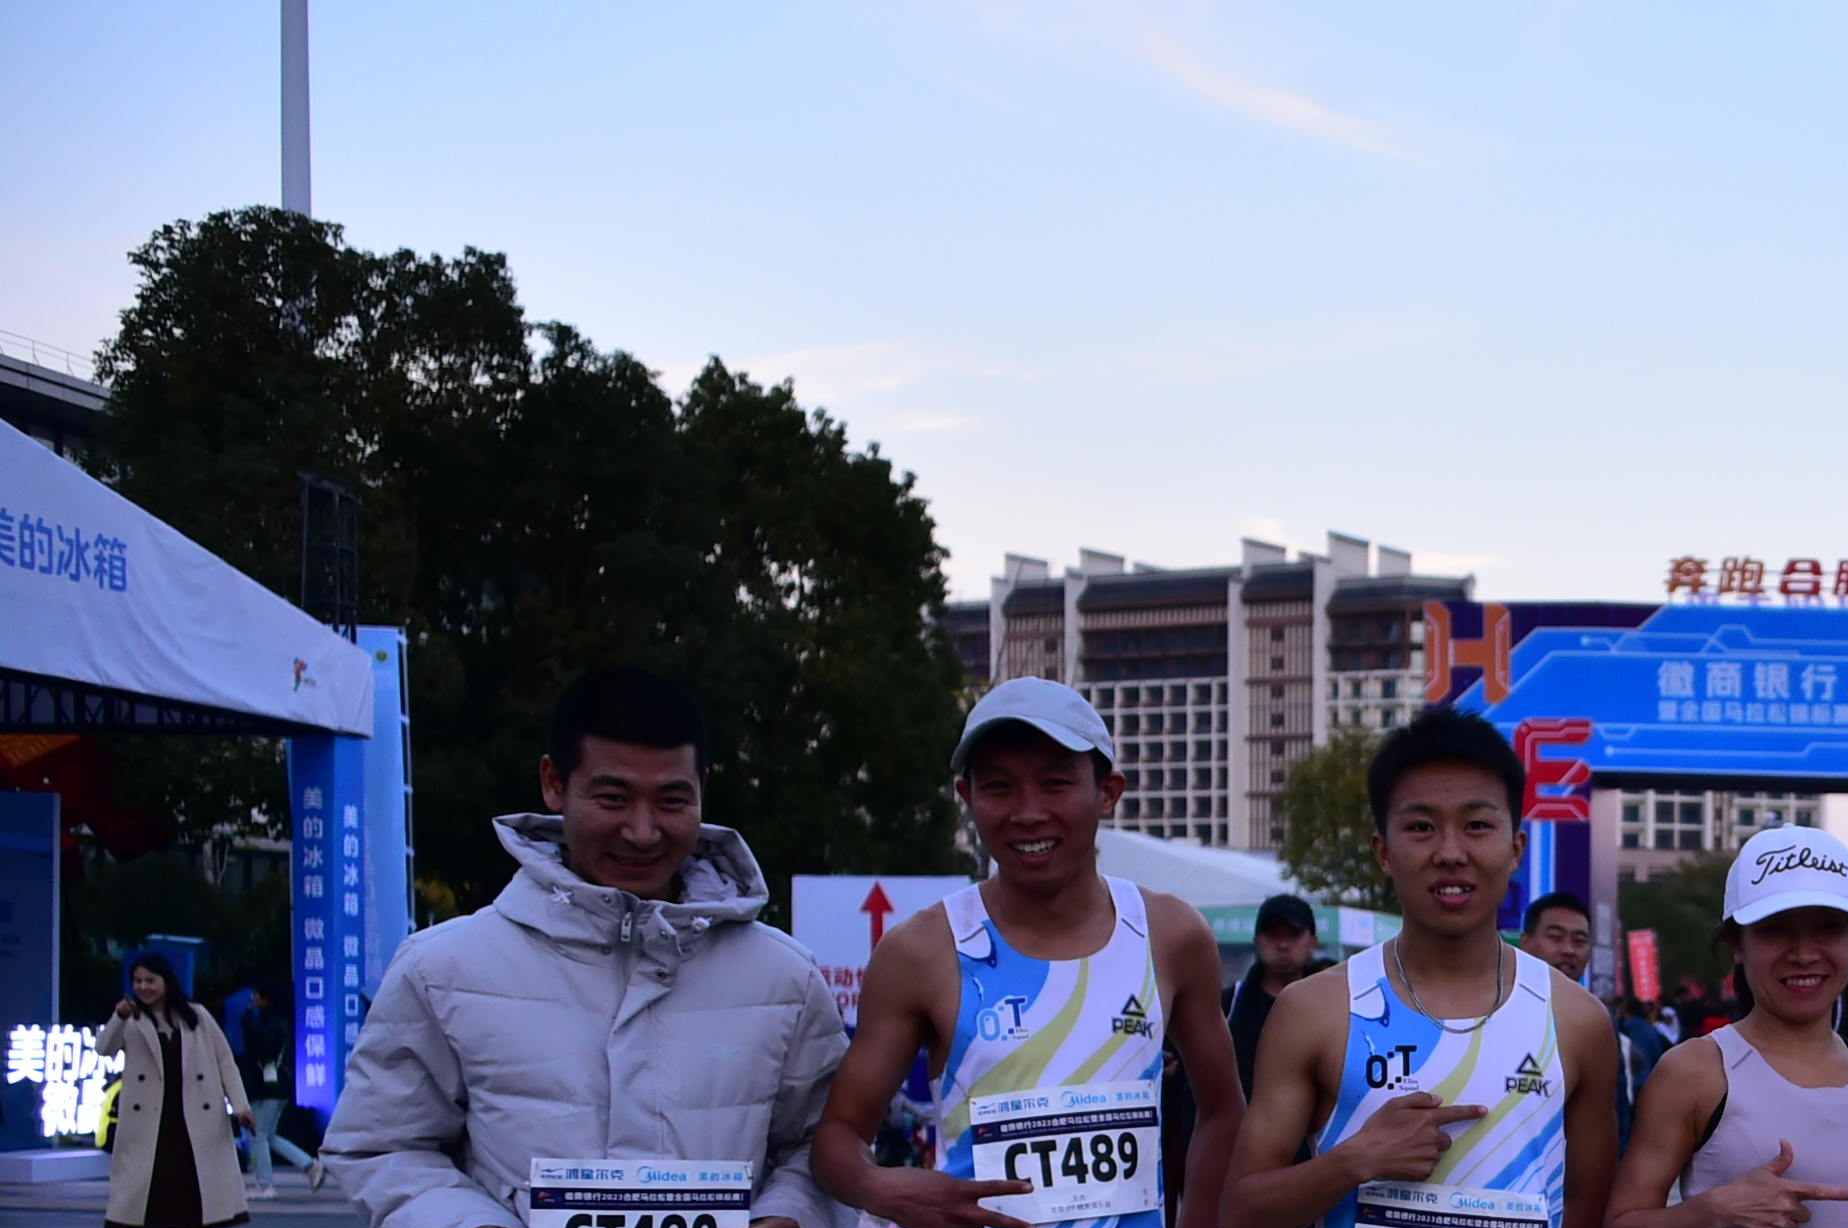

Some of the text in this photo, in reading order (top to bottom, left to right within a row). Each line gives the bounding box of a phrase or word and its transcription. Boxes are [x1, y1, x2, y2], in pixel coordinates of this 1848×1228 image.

[302, 787, 324, 898] 美的冰箱
[1751, 844, 1848, 885] Titleist
[1112, 1017, 1153, 1039] PEAK
[1506, 1078, 1550, 1097] PEAK
[1005, 1132, 1138, 1188] CT489
[565, 1168, 624, 1180] 鸿星尔克
[1386, 1188, 1438, 1204] 鸿星尔克
